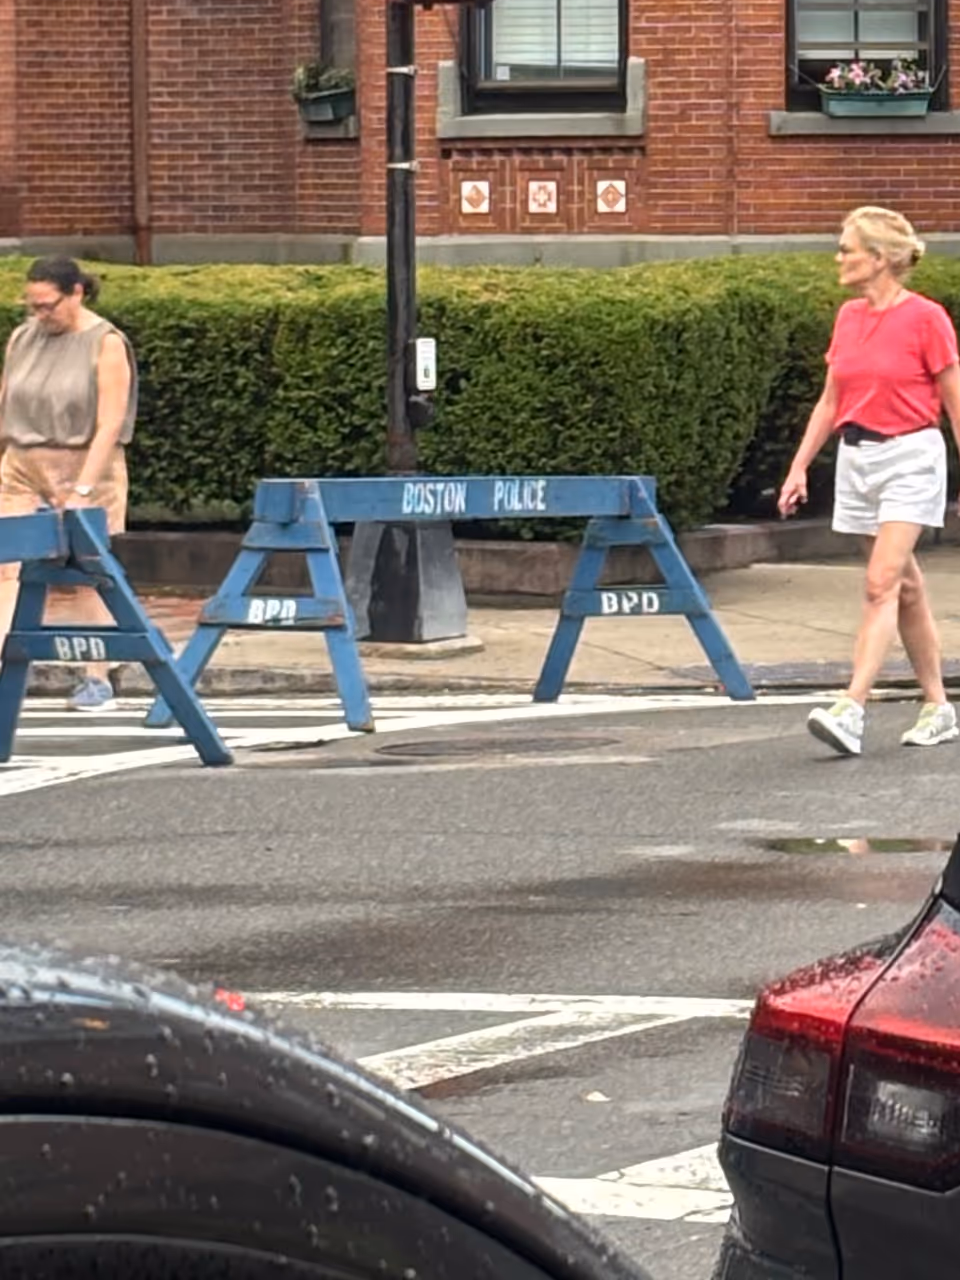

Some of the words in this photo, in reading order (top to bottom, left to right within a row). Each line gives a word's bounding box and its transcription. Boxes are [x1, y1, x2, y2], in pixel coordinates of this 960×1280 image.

[402, 482, 467, 514] BOSTON
[493, 480, 547, 511] POLICE
[248, 599, 297, 624] BPD
[602, 592, 660, 614] BPD
[54, 636, 106, 661] BPD
